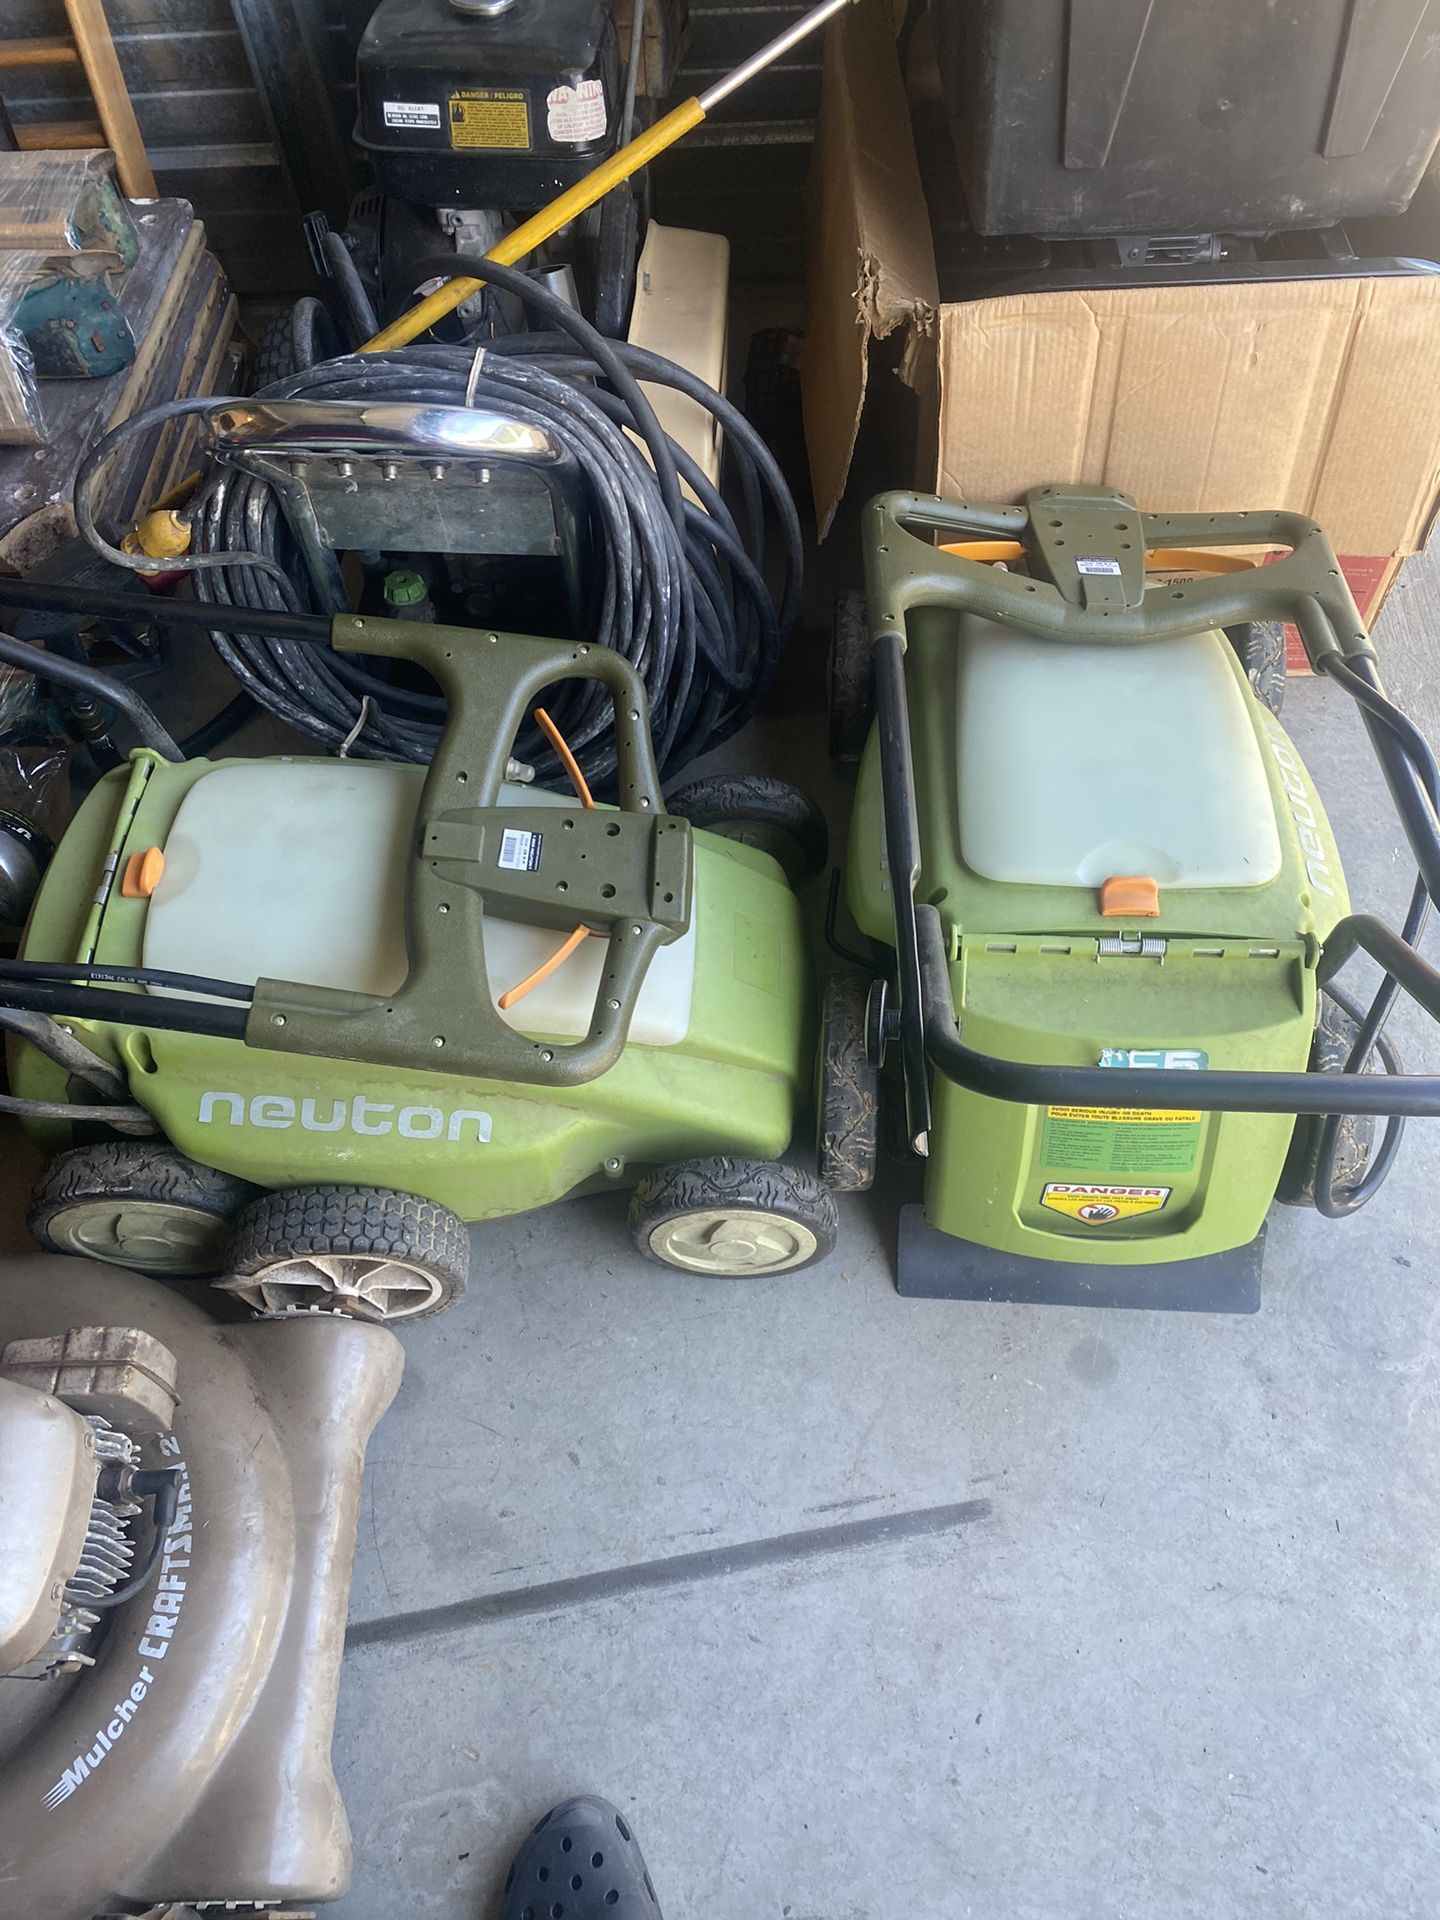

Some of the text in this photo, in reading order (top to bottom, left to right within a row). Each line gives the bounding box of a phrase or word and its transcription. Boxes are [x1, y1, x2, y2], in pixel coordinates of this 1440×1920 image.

[494, 92, 524, 100] PELIGRO
[197, 1090, 494, 1144] neuton
[1052, 1185, 1161, 1196] DANGER
[48, 1665, 154, 1805] Mulcher
[156, 1431, 181, 1457] 2
